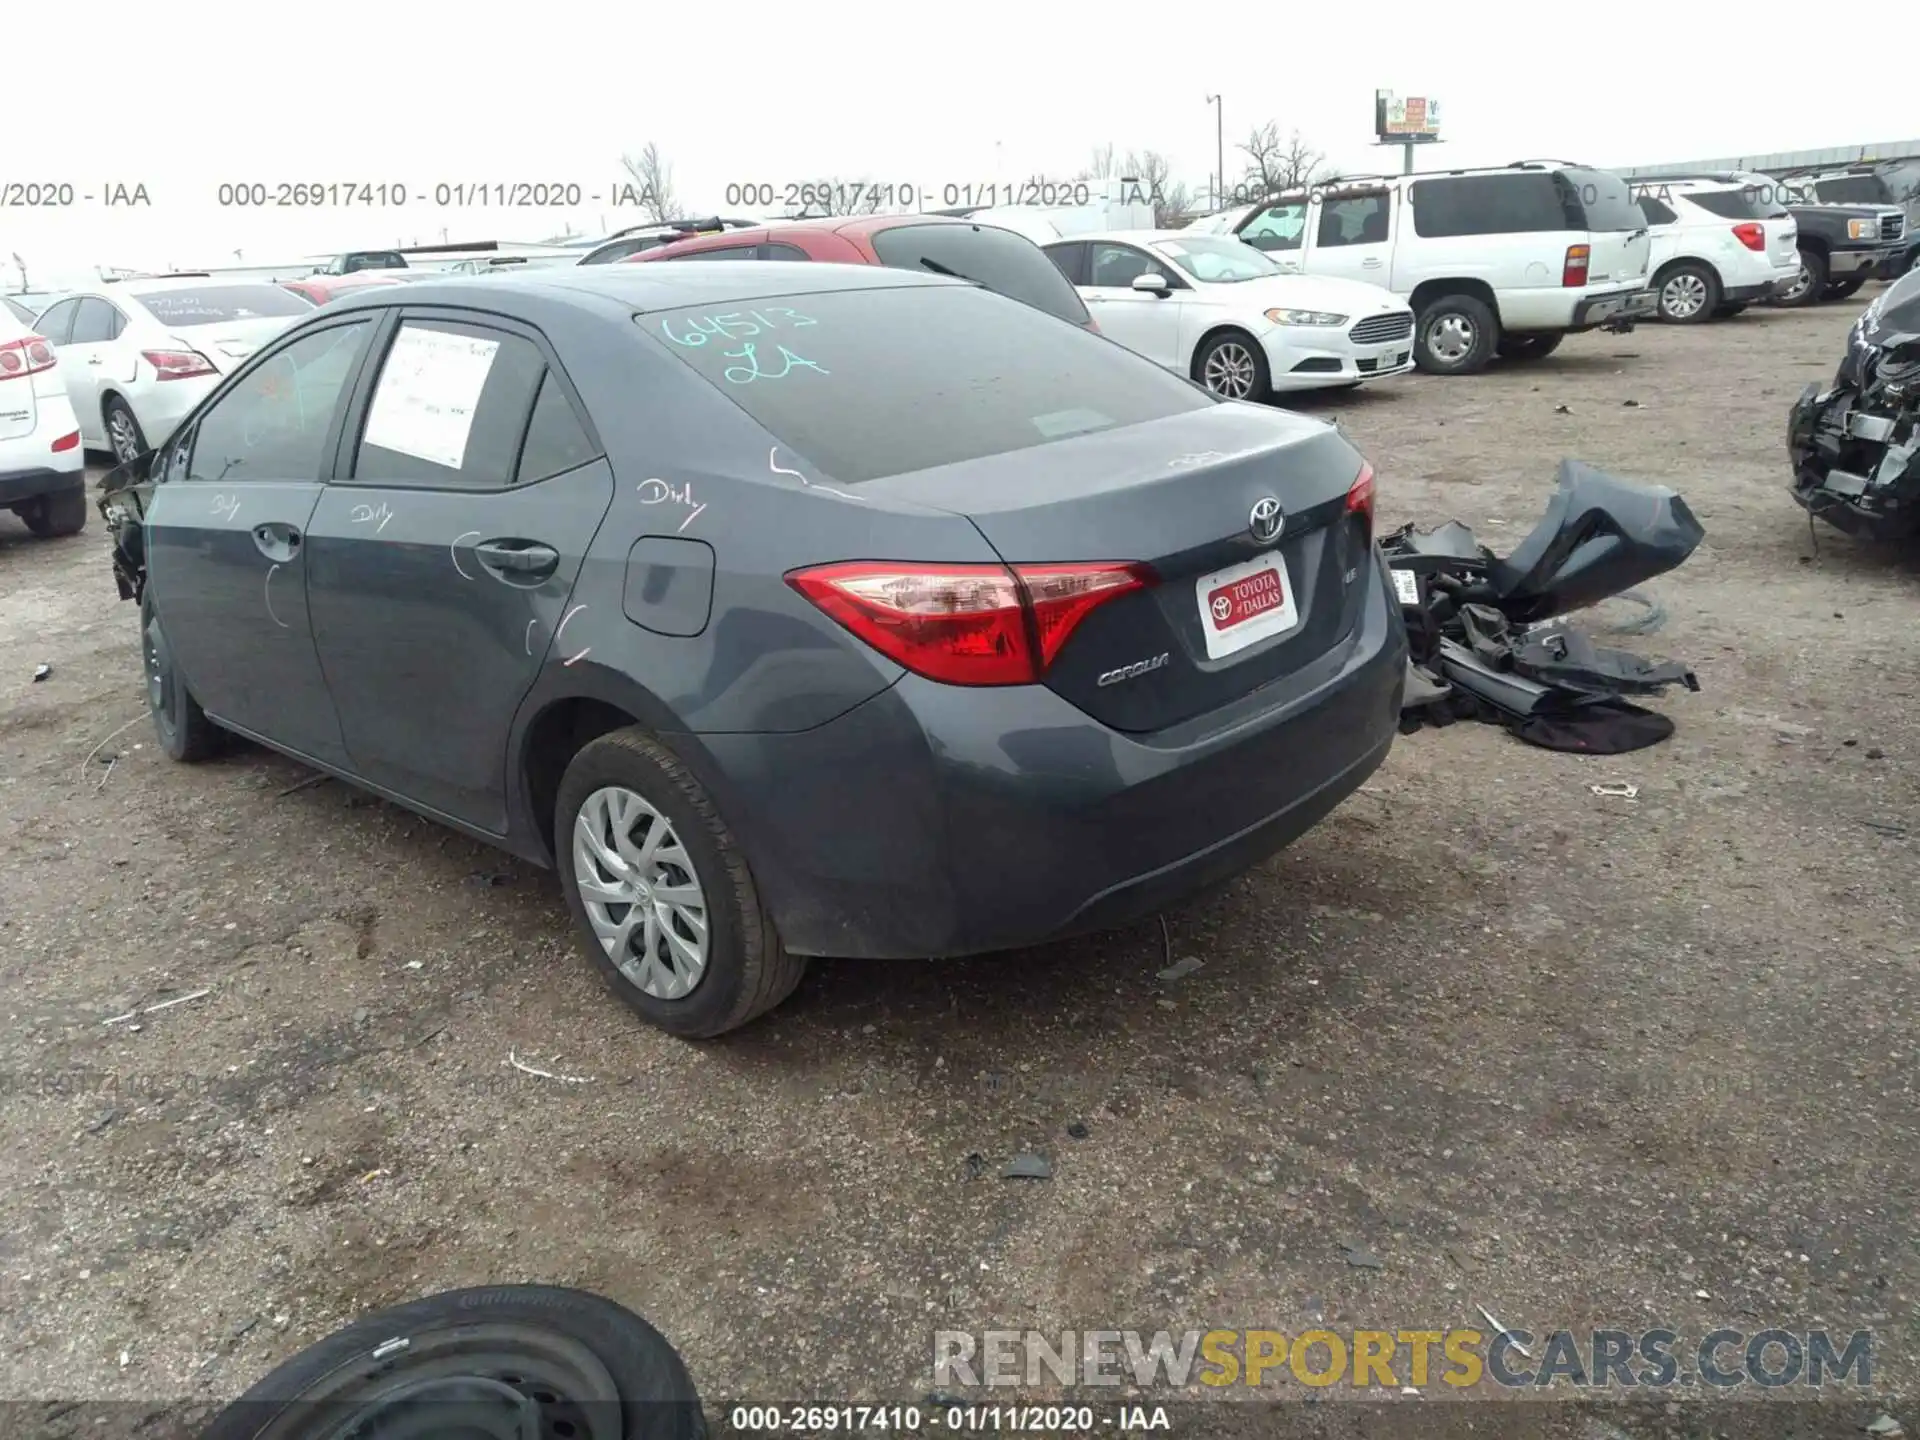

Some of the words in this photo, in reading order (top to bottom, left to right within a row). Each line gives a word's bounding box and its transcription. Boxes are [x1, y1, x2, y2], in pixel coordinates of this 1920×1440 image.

[662, 307, 818, 346] 64513
[1232, 573, 1277, 601] TOYOTA
[1243, 589, 1280, 615] DALLAS
[1097, 652, 1169, 687] COROLLA
